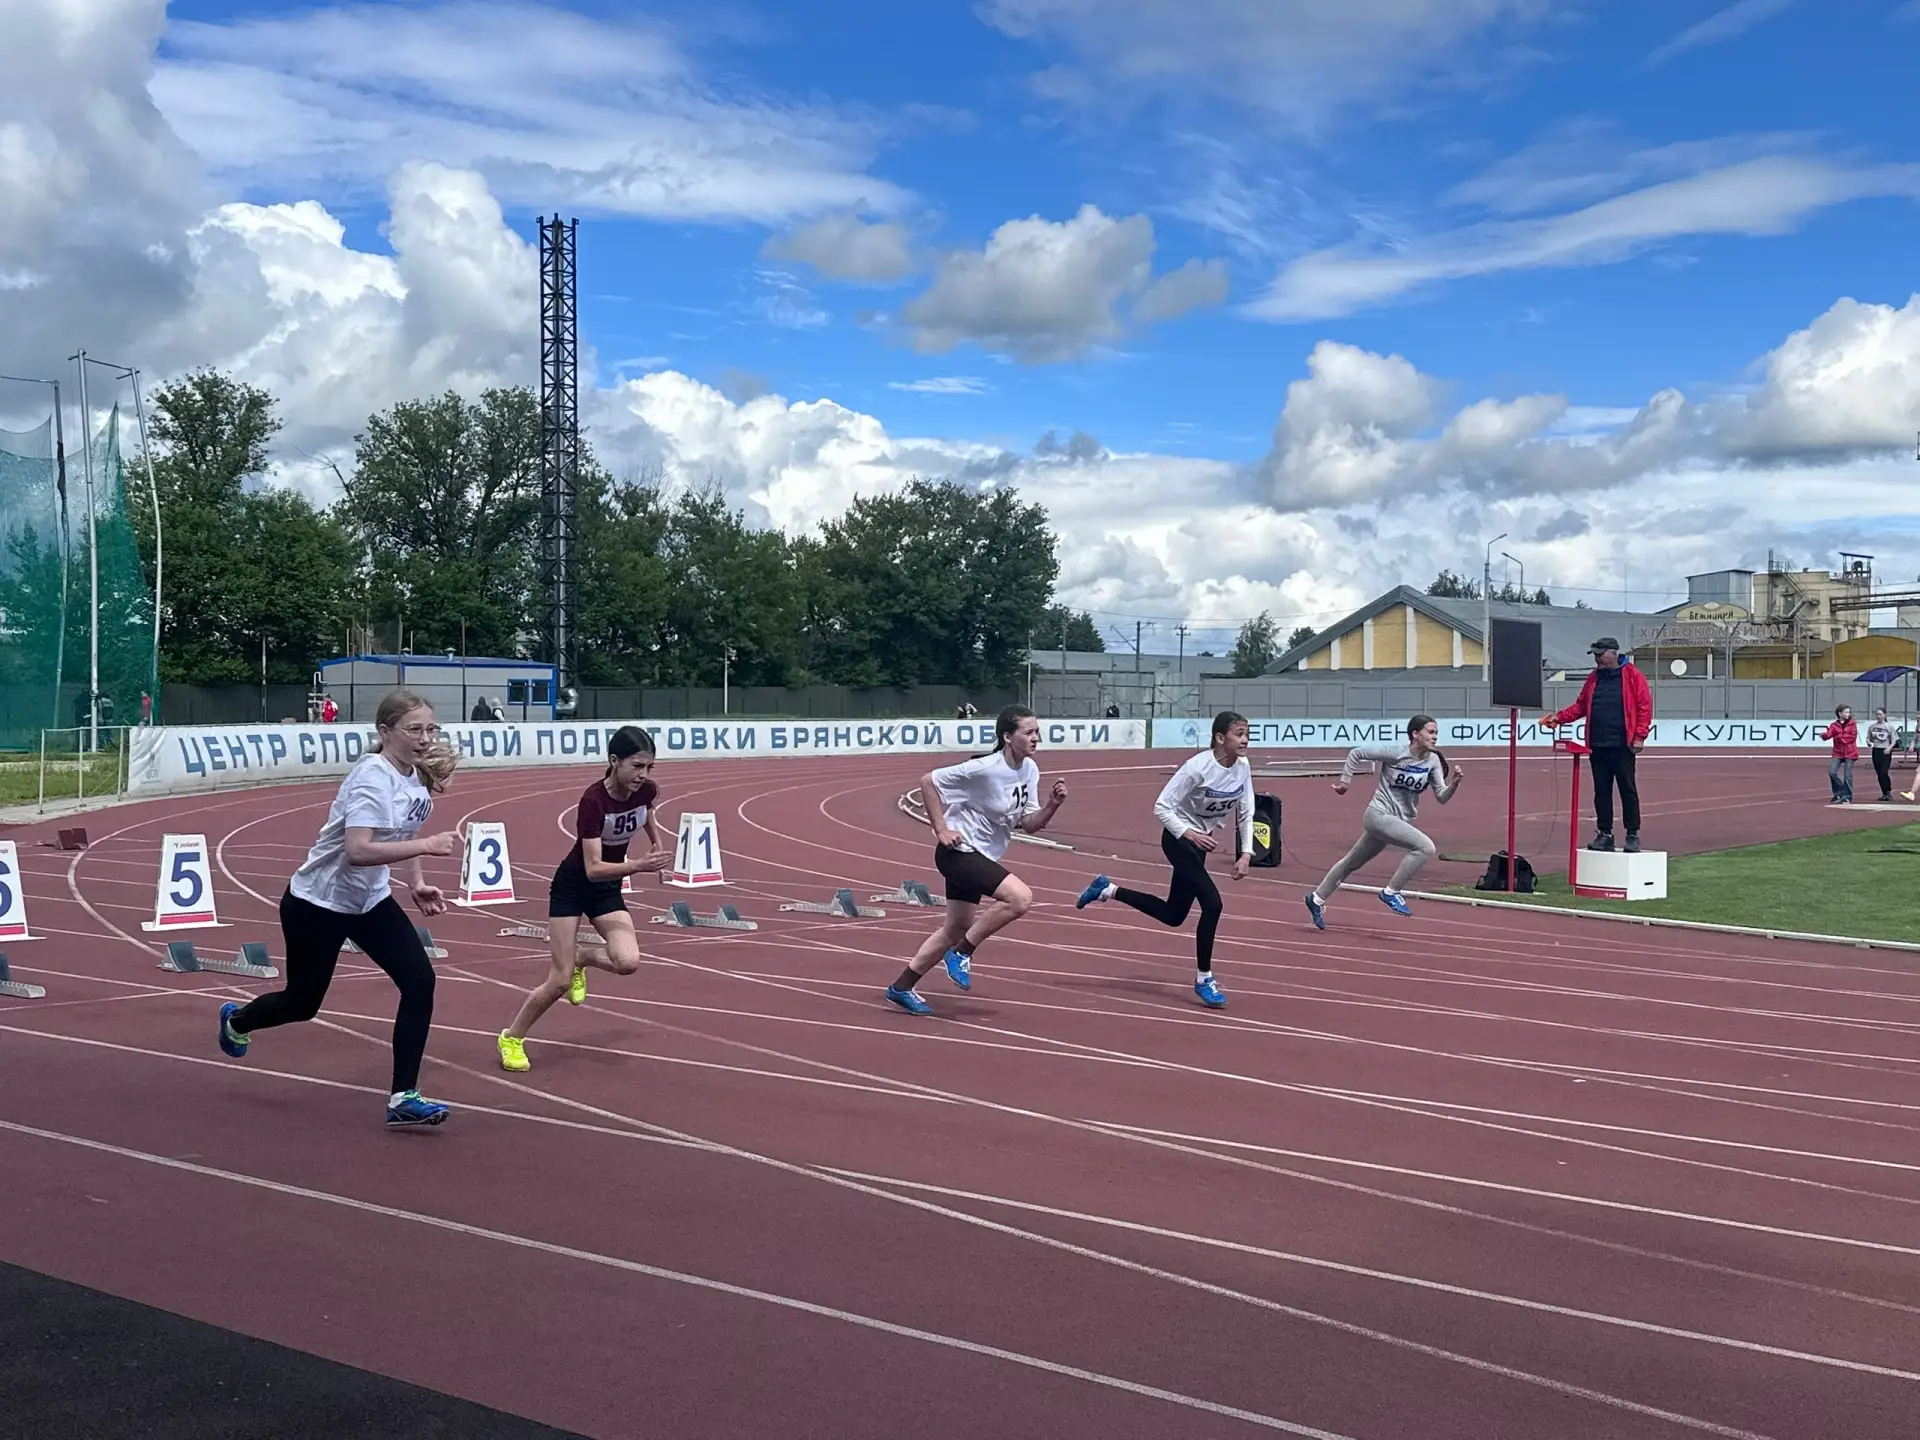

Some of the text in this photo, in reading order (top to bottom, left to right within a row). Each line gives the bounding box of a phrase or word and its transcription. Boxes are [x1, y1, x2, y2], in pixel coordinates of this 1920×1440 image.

[1640, 624, 1789, 638] ХЛЕБОКОМБИНАТ
[1248, 724, 1409, 741] ЕПАРТАМЕН
[1684, 725, 1827, 741] КУЛЬТУР
[179, 722, 1109, 777] ЦЕНТР СПОНОЙ ПОДГТОВКИ БРЯНСКОЙ ОБСТИ
[1395, 773, 1422, 789] 806
[1012, 784, 1028, 809] 15
[1206, 800, 1237, 812] 430
[407, 798, 431, 821] 240
[613, 811, 637, 835] 95
[681, 827, 689, 869] 1
[698, 827, 712, 869] 1
[463, 838, 471, 885] 3
[478, 838, 503, 885] 3
[170, 852, 203, 907] 5
